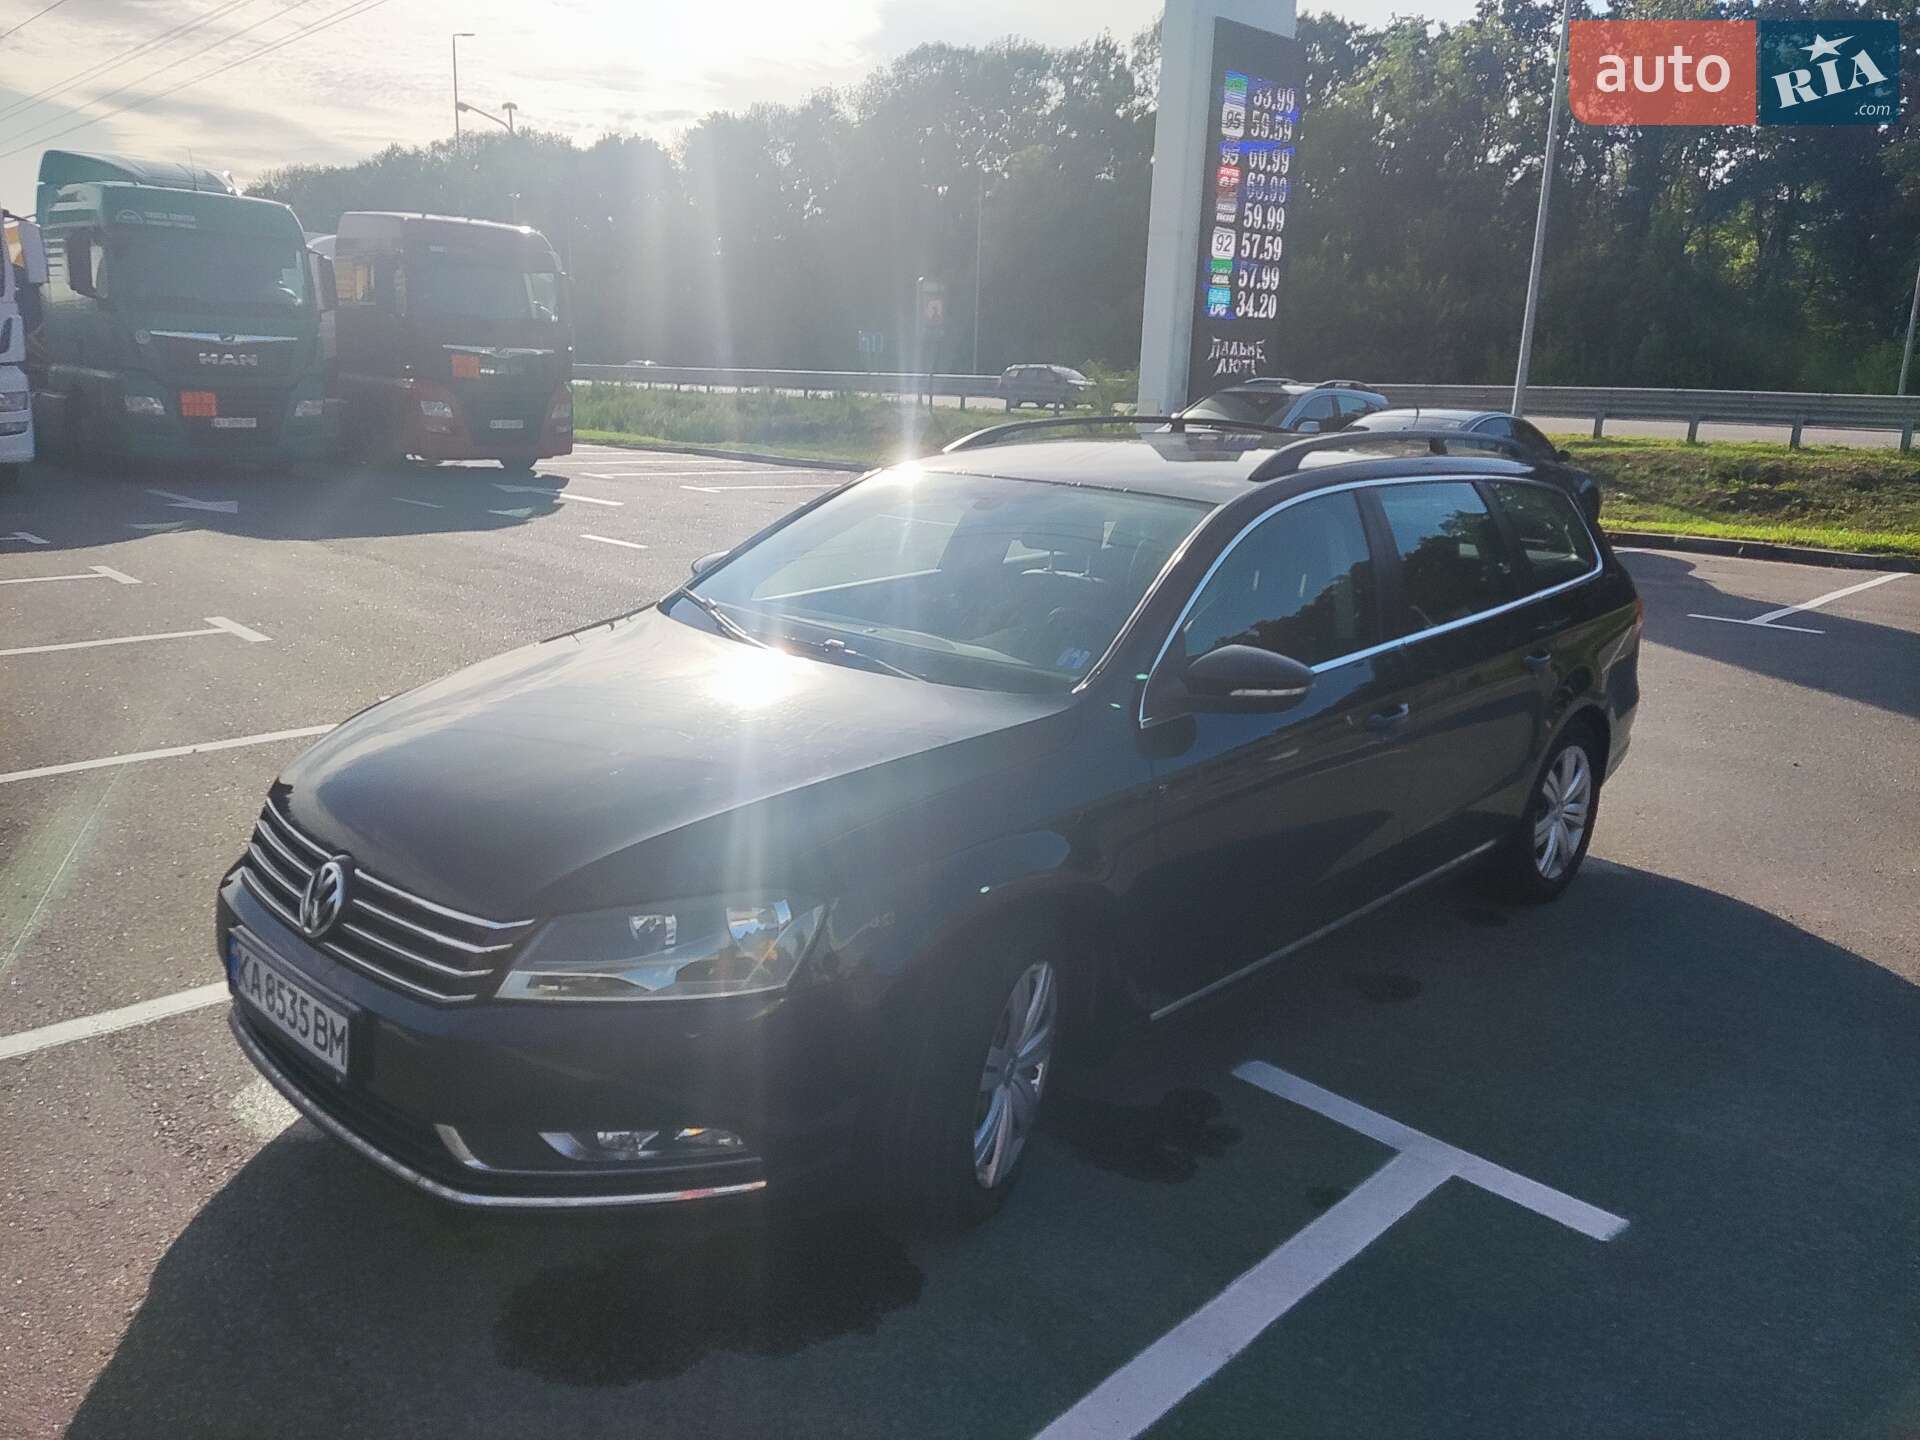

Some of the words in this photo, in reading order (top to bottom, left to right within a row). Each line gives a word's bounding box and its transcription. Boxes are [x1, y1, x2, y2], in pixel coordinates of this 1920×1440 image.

[1243, 202, 1285, 232] 59.99
[1216, 234, 1232, 252] 92
[1240, 232, 1282, 261] 57.59
[1238, 261, 1280, 290] 57.99
[1236, 291, 1277, 319] 34.20
